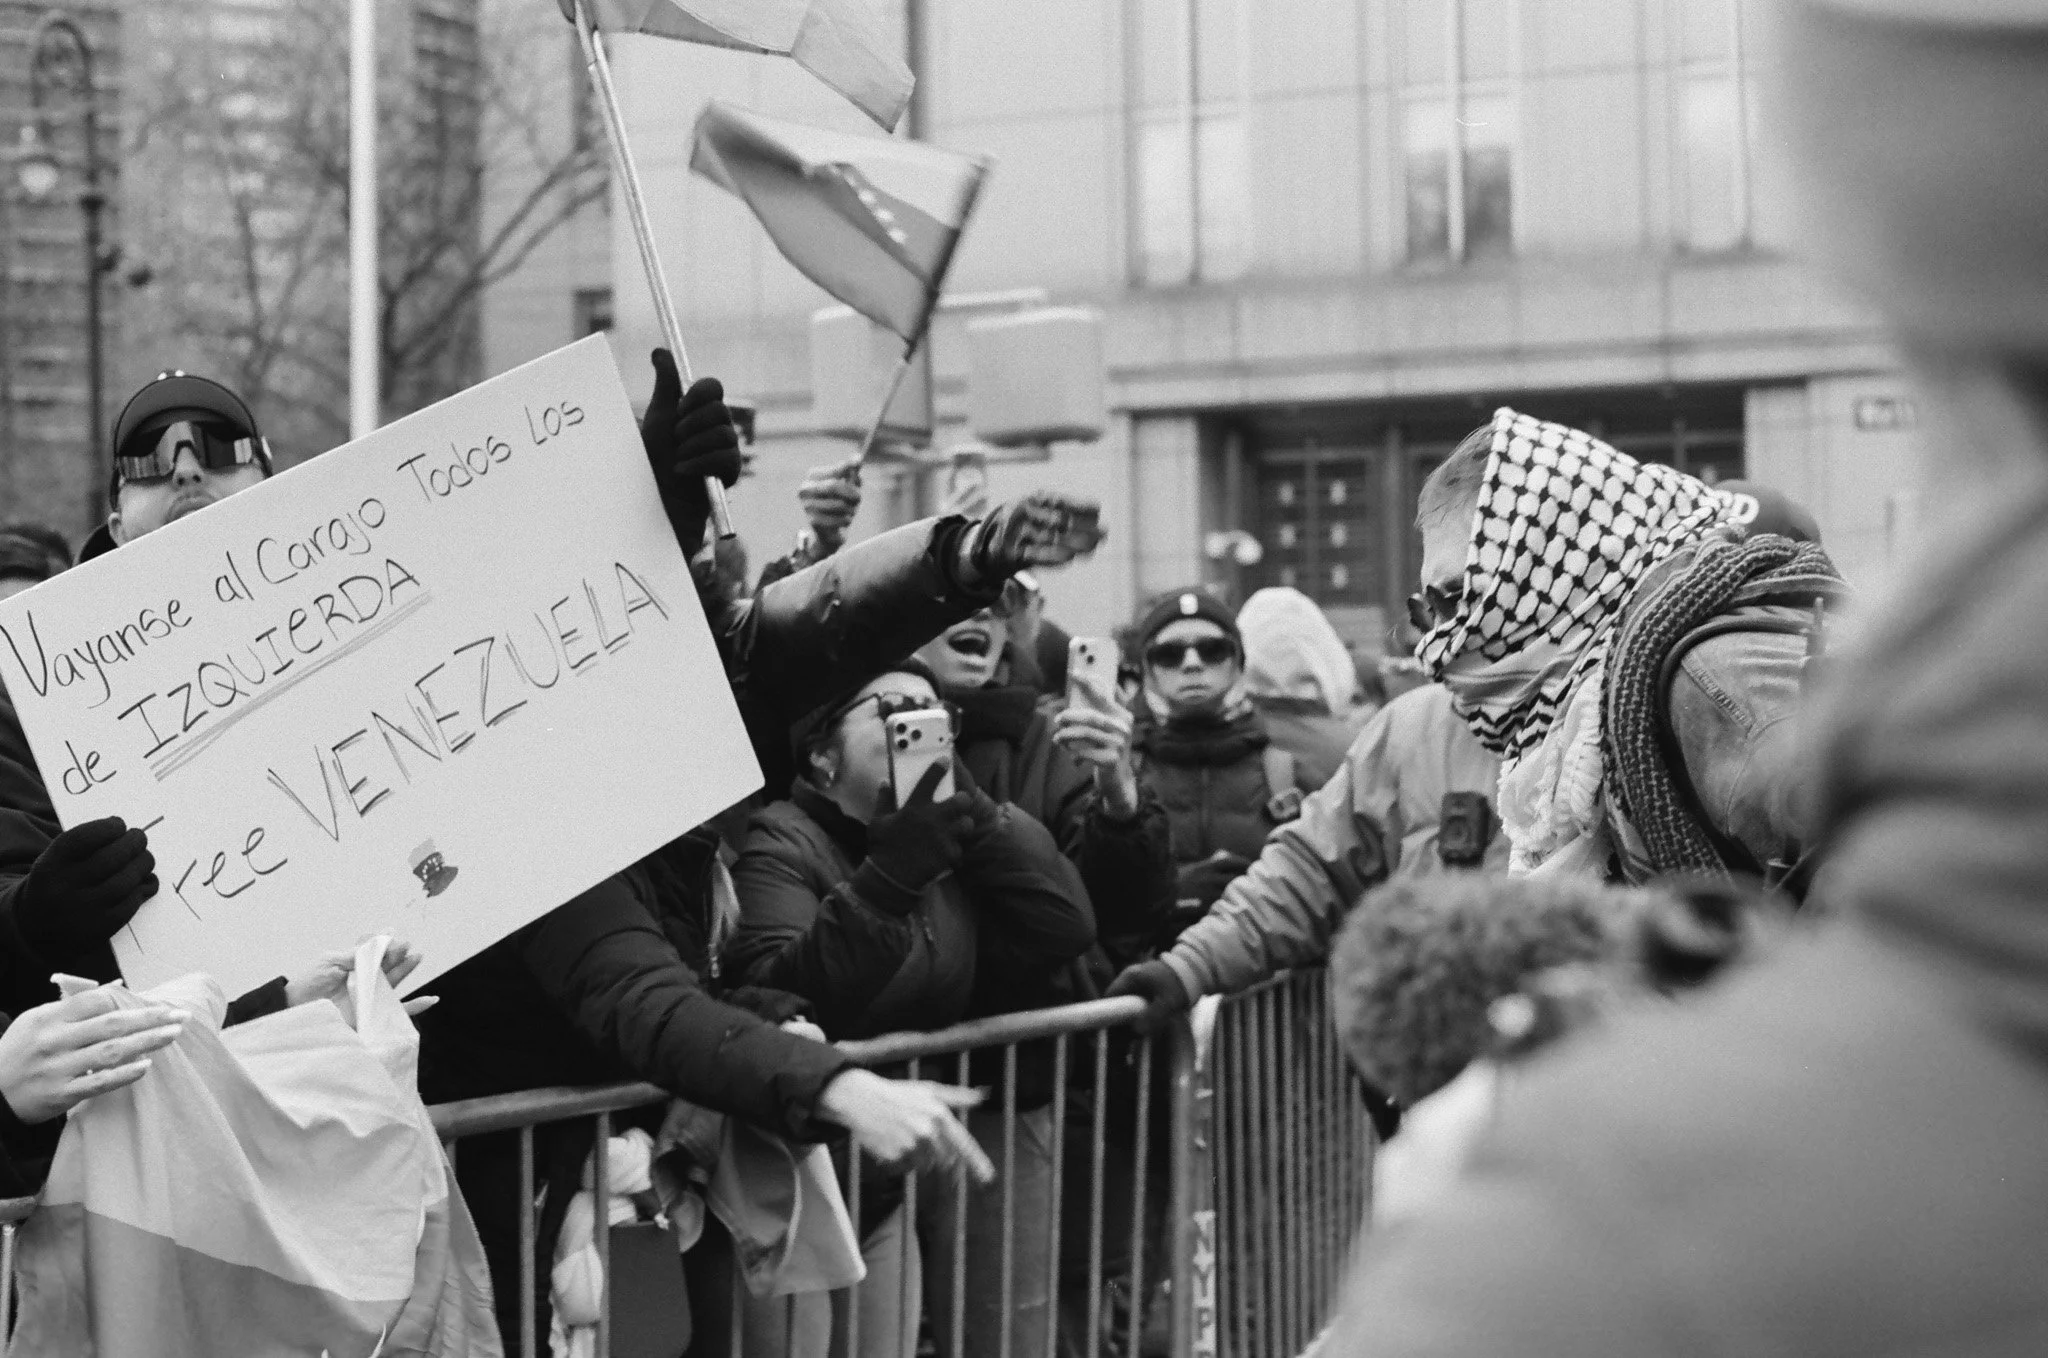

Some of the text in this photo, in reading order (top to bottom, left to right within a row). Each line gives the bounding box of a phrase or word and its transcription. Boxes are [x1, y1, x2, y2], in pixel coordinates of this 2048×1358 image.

[0, 400, 585, 709] Vayanse al Carajo Todos Los
[62, 740, 118, 796] de
[266, 562, 670, 843] VENEZUELA
